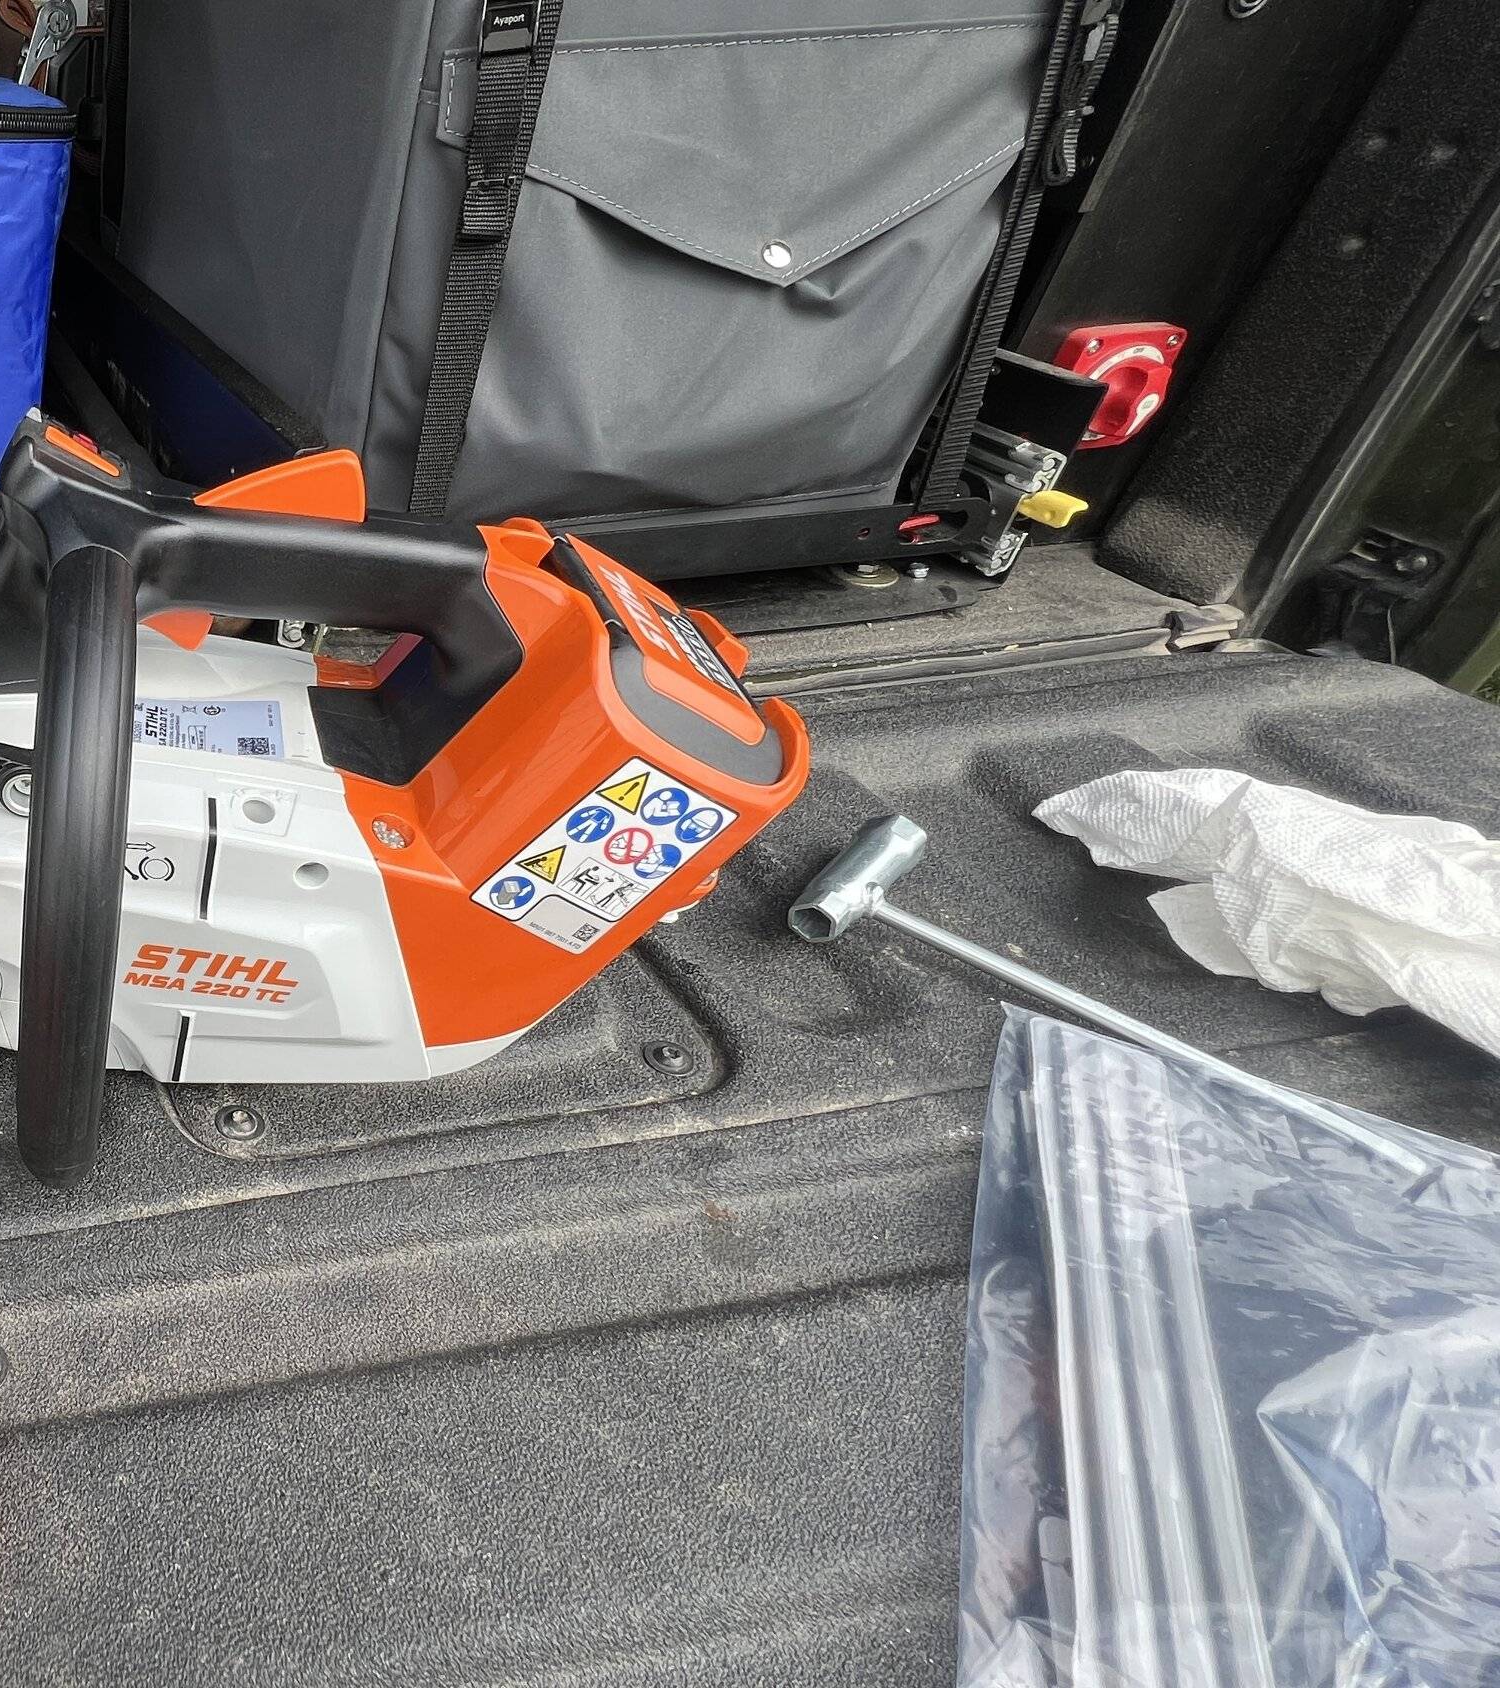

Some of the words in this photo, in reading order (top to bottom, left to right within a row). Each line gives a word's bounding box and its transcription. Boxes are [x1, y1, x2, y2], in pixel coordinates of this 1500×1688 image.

[145, 706, 158, 738] STIHL
[160, 708, 168, 716] TC
[131, 944, 299, 988] STIHL
[123, 972, 186, 991] MSA
[190, 981, 250, 998] 220
[255, 988, 291, 1003] TC
